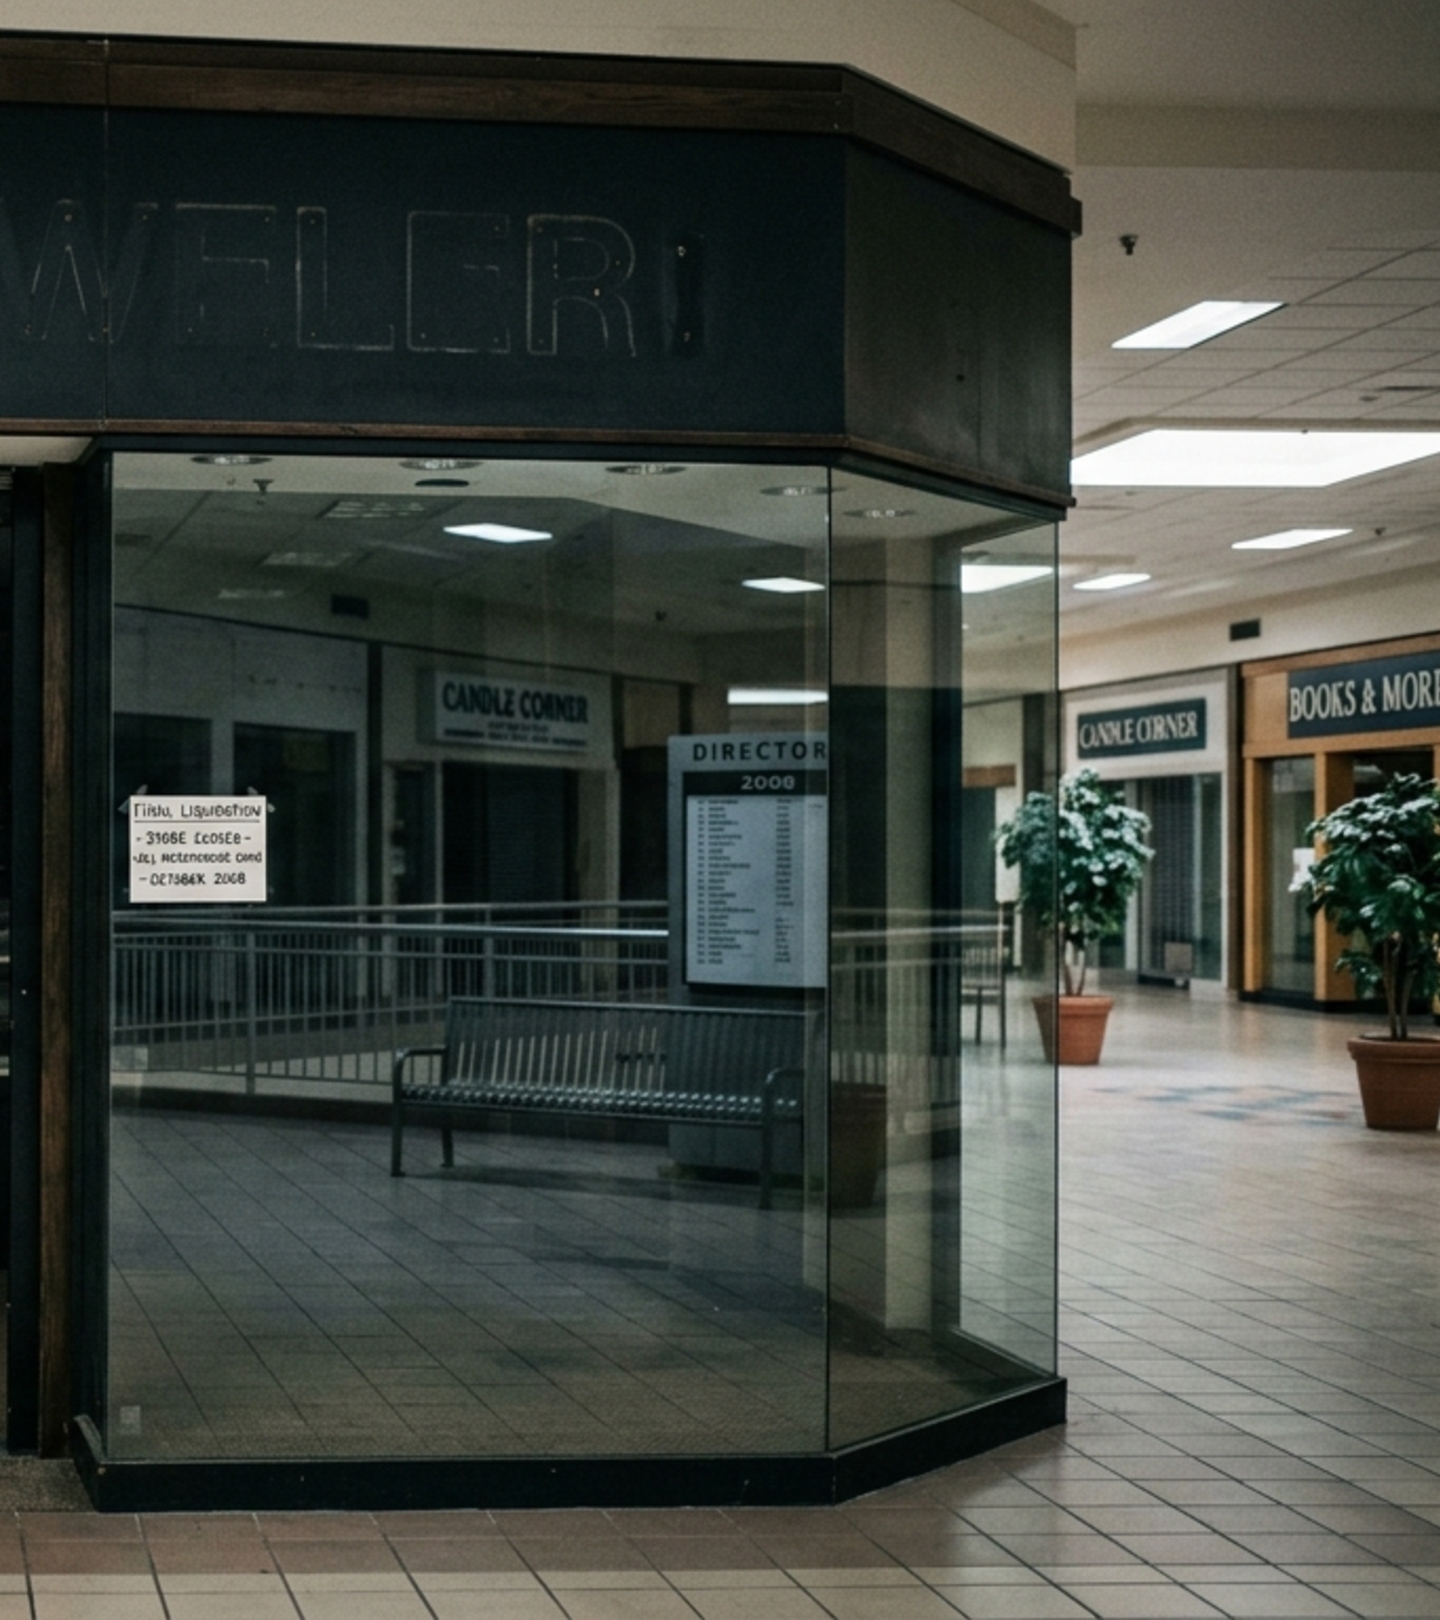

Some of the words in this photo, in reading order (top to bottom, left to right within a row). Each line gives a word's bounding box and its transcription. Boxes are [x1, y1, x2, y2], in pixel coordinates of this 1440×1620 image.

[442, 681, 516, 719] CANDLE
[518, 689, 589, 725] CORNER
[1289, 679, 1357, 723] BOOKS
[1361, 678, 1377, 715] &
[692, 741, 827, 762] DIRECTOR
